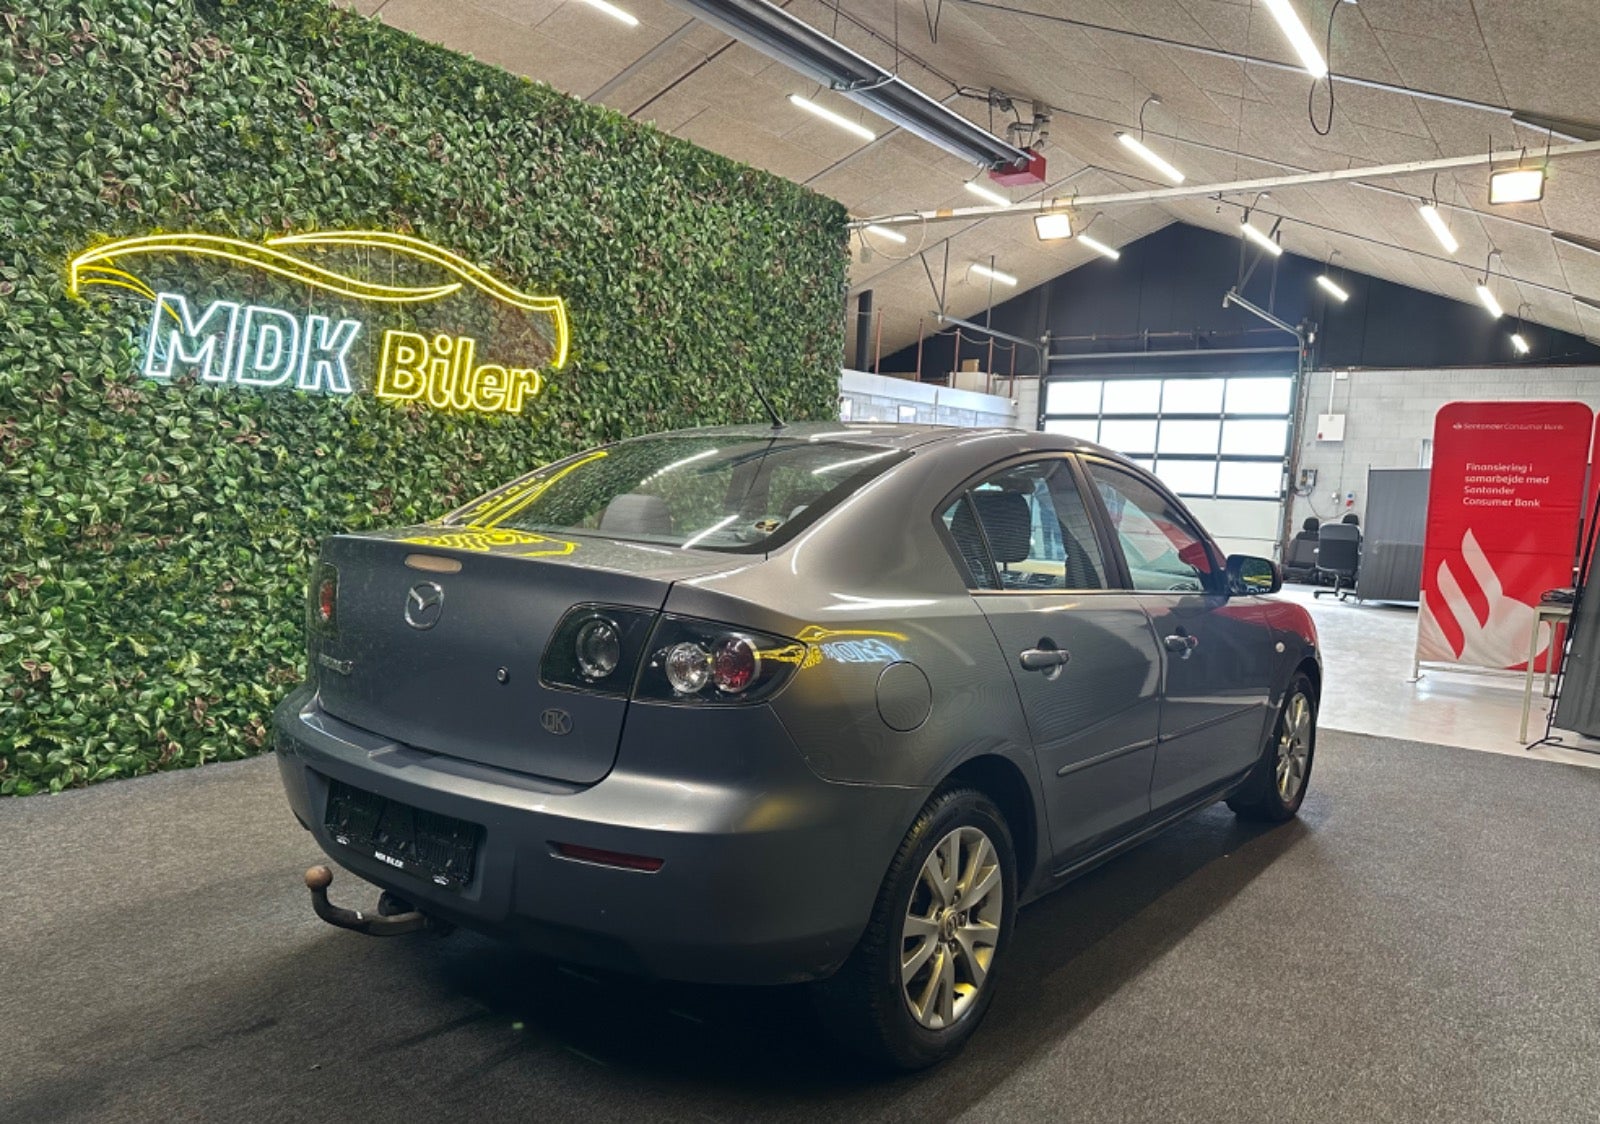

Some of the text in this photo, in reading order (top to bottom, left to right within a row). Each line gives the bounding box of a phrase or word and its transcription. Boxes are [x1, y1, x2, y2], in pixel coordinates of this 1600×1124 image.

[145, 292, 541, 413] MDK Biler
[1466, 462, 1527, 474] Finansiering
[1464, 474, 1550, 486] samarbejde med
[1463, 485, 1516, 495] Santander
[1462, 496, 1540, 508] Consumer Bank
[546, 711, 567, 734] DK
